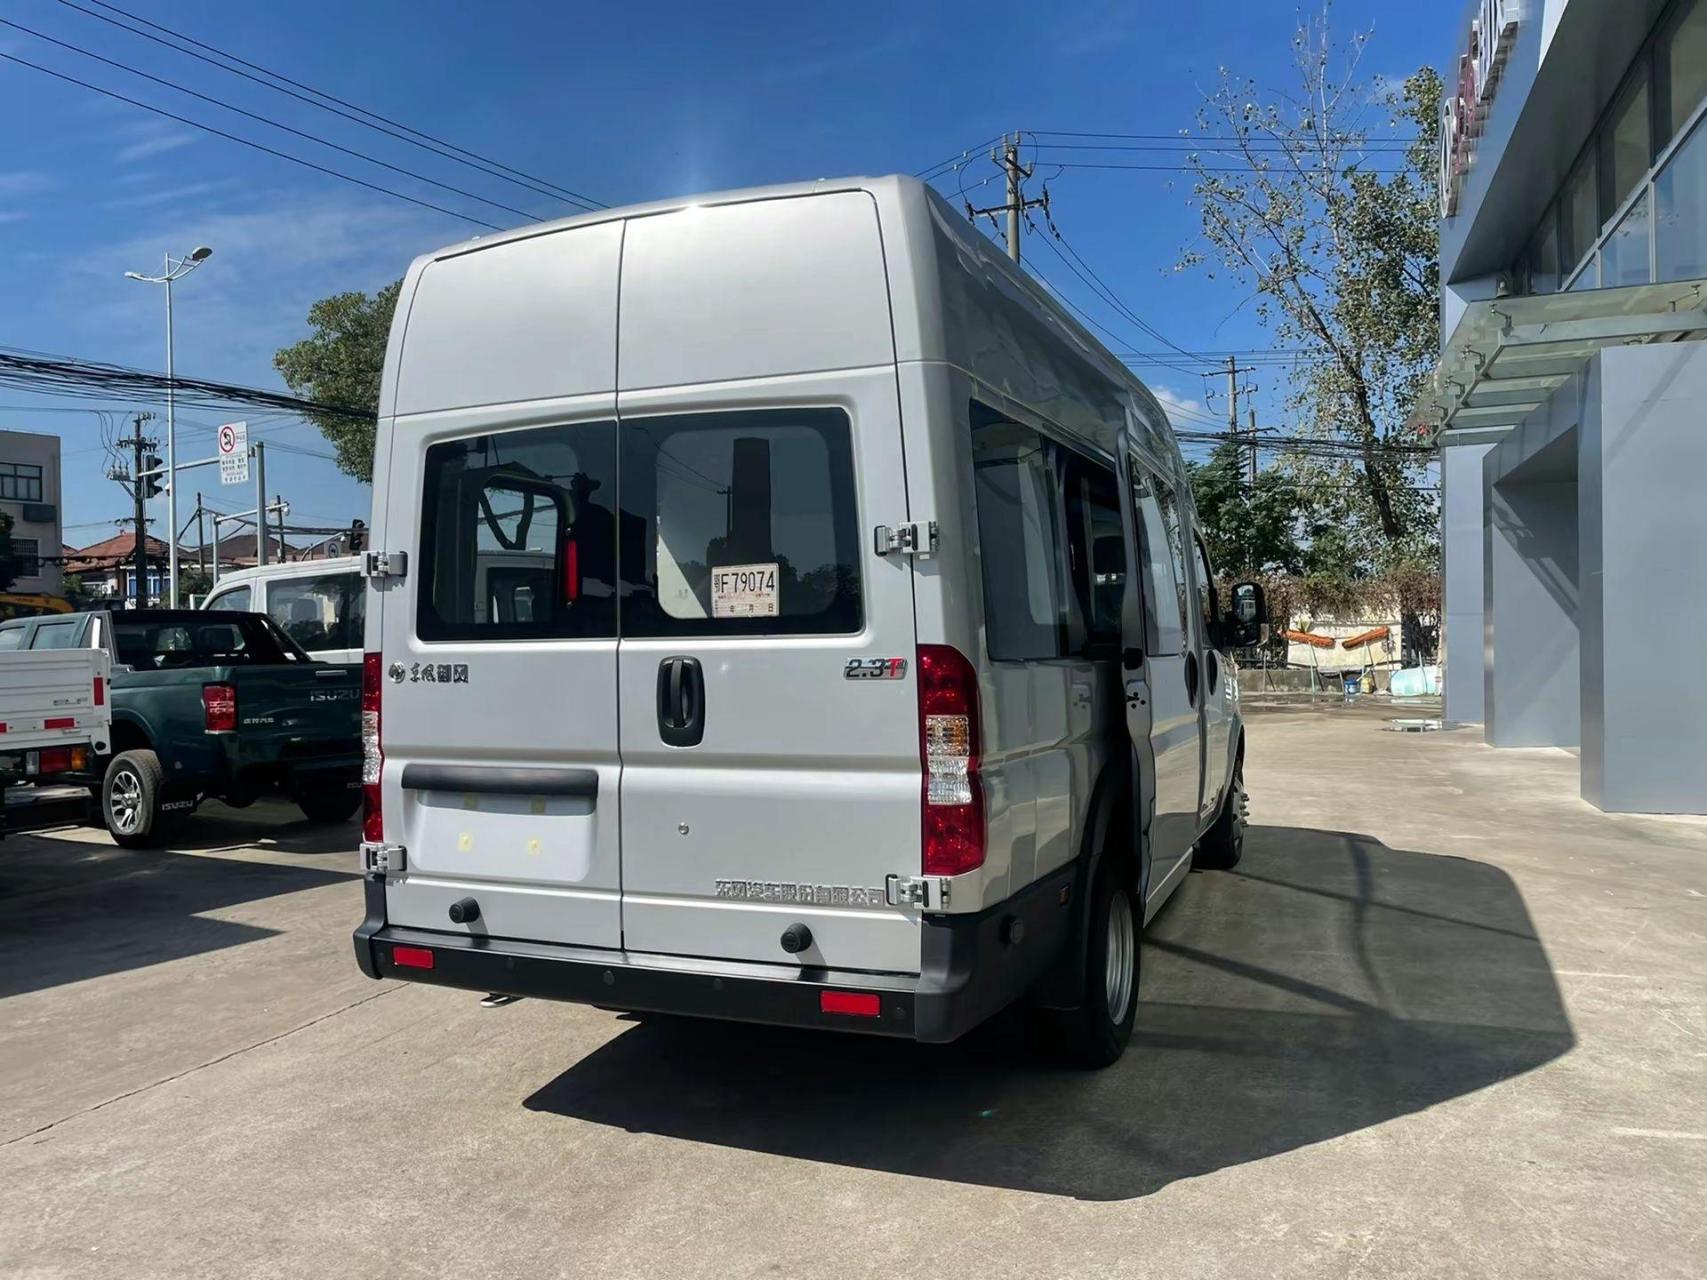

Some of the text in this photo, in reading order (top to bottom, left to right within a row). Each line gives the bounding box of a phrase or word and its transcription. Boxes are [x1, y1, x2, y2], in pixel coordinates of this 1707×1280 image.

[846, 658, 905, 678] 2.3T
[310, 689, 360, 702] ISUZU
[161, 799, 194, 811] ISUZU
